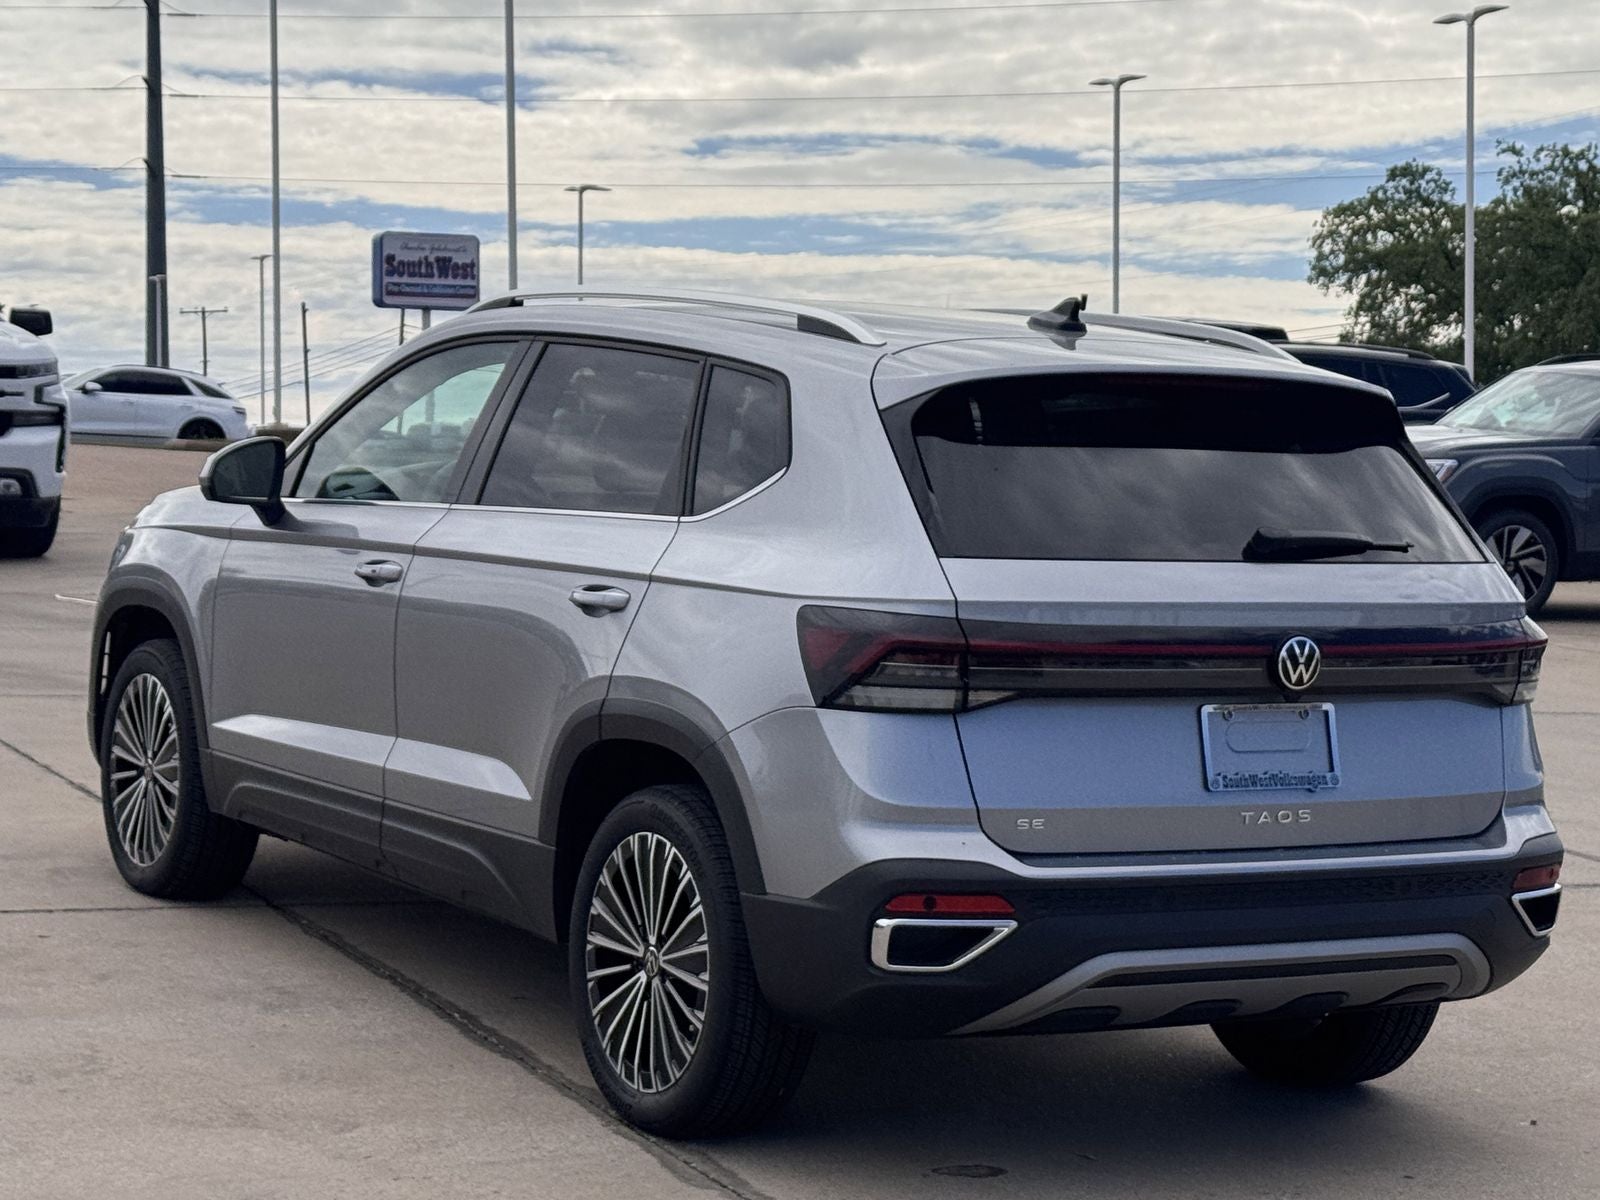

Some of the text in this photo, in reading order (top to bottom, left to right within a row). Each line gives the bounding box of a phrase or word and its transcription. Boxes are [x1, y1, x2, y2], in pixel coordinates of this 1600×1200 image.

[1281, 638, 1319, 686] VW
[1016, 818, 1045, 830] SE
[1241, 810, 1311, 824] TAOS
